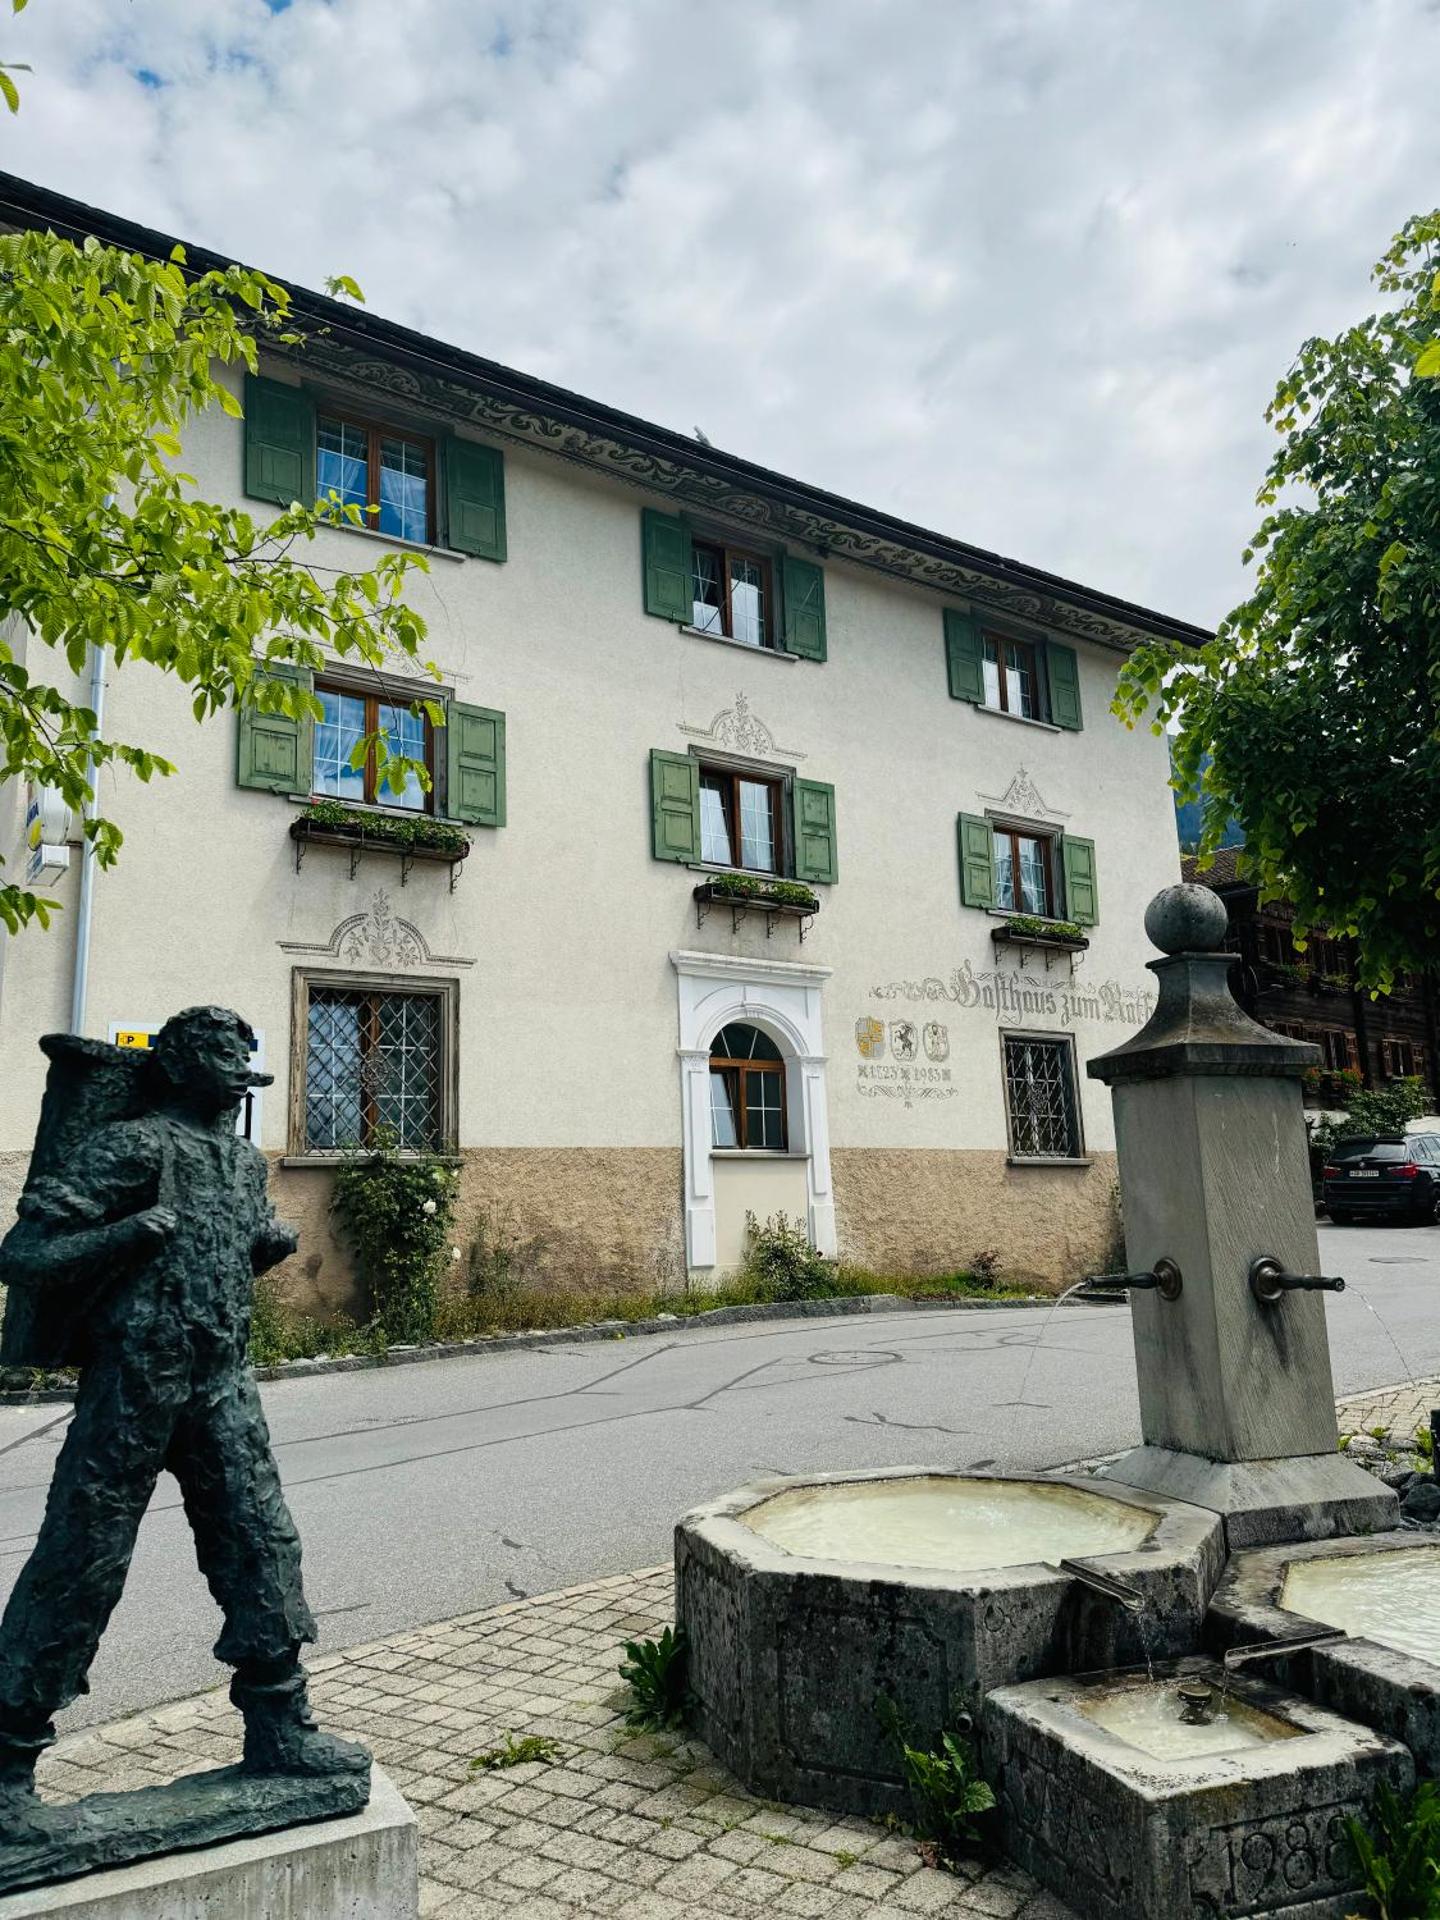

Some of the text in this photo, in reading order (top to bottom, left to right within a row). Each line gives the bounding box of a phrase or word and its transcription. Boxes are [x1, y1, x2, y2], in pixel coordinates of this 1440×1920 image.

[956, 959, 1155, 1027] Gasthaus zum Rath
[127, 1035, 135, 1045] P
